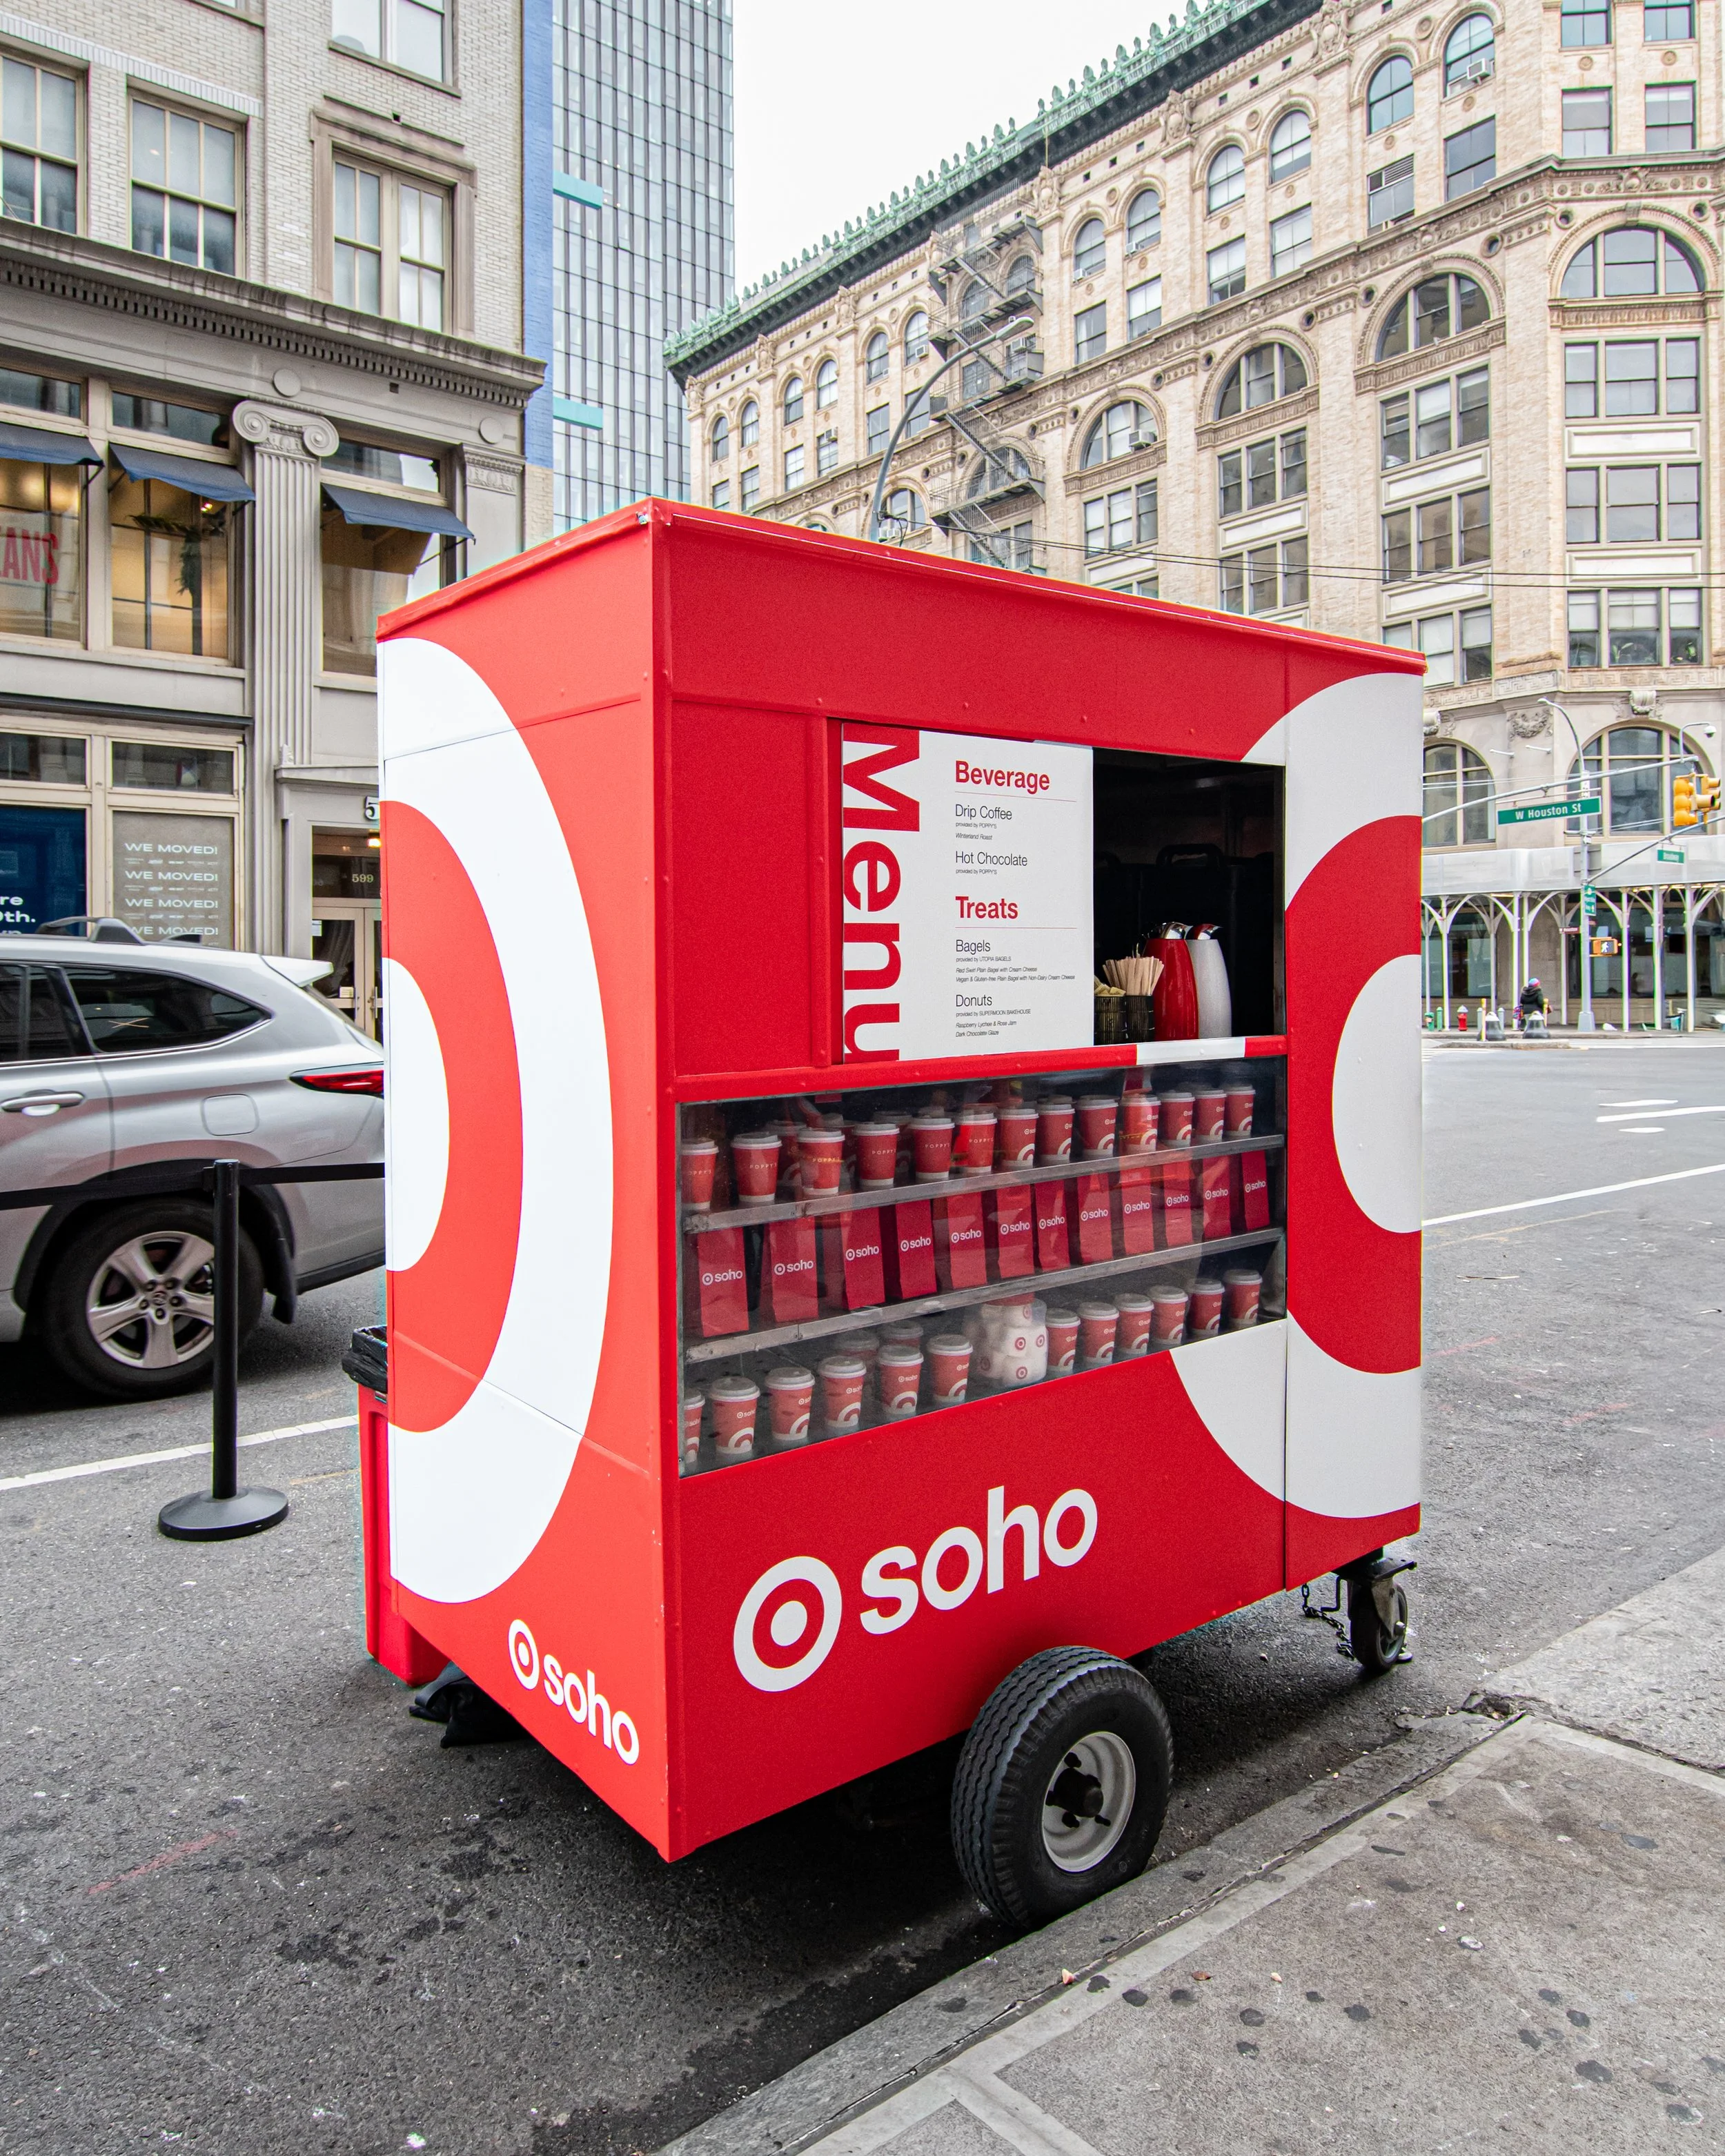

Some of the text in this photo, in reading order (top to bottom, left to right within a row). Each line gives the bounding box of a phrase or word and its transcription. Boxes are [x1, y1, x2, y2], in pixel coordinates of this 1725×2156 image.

[0, 526, 59, 585] ANS
[955, 760, 1050, 795] Beverage
[955, 804, 1012, 820] Drip Coffee
[1515, 802, 1582, 820] W Houston St
[124, 843, 218, 855] WE MOVED!
[956, 851, 1028, 866] Hot Chocolate
[125, 871, 218, 881] WE MOVED!
[352, 873, 374, 883] 599
[842, 722, 920, 1062] Menu
[125, 898, 218, 909] WE MOVED!
[955, 896, 1018, 919] Treats
[130, 927, 218, 935] WE MOVED!
[956, 939, 991, 955] Bagels
[956, 994, 992, 1007] Donuts
[1251, 1180, 1266, 1190] soho
[1212, 1188, 1229, 1198] soho
[1132, 1200, 1150, 1211] soho
[1172, 1194, 1189, 1205] soho
[1088, 1209, 1109, 1219] soho
[1009, 1220, 1030, 1232] soho
[1046, 1215, 1065, 1227] soho
[960, 1229, 982, 1241] soho
[909, 1236, 931, 1249] soho
[856, 1245, 880, 1260] soho
[786, 1260, 814, 1272] soho
[714, 1269, 743, 1282] soho
[860, 1485, 1098, 1635] soho
[543, 1653, 640, 1766] soho
